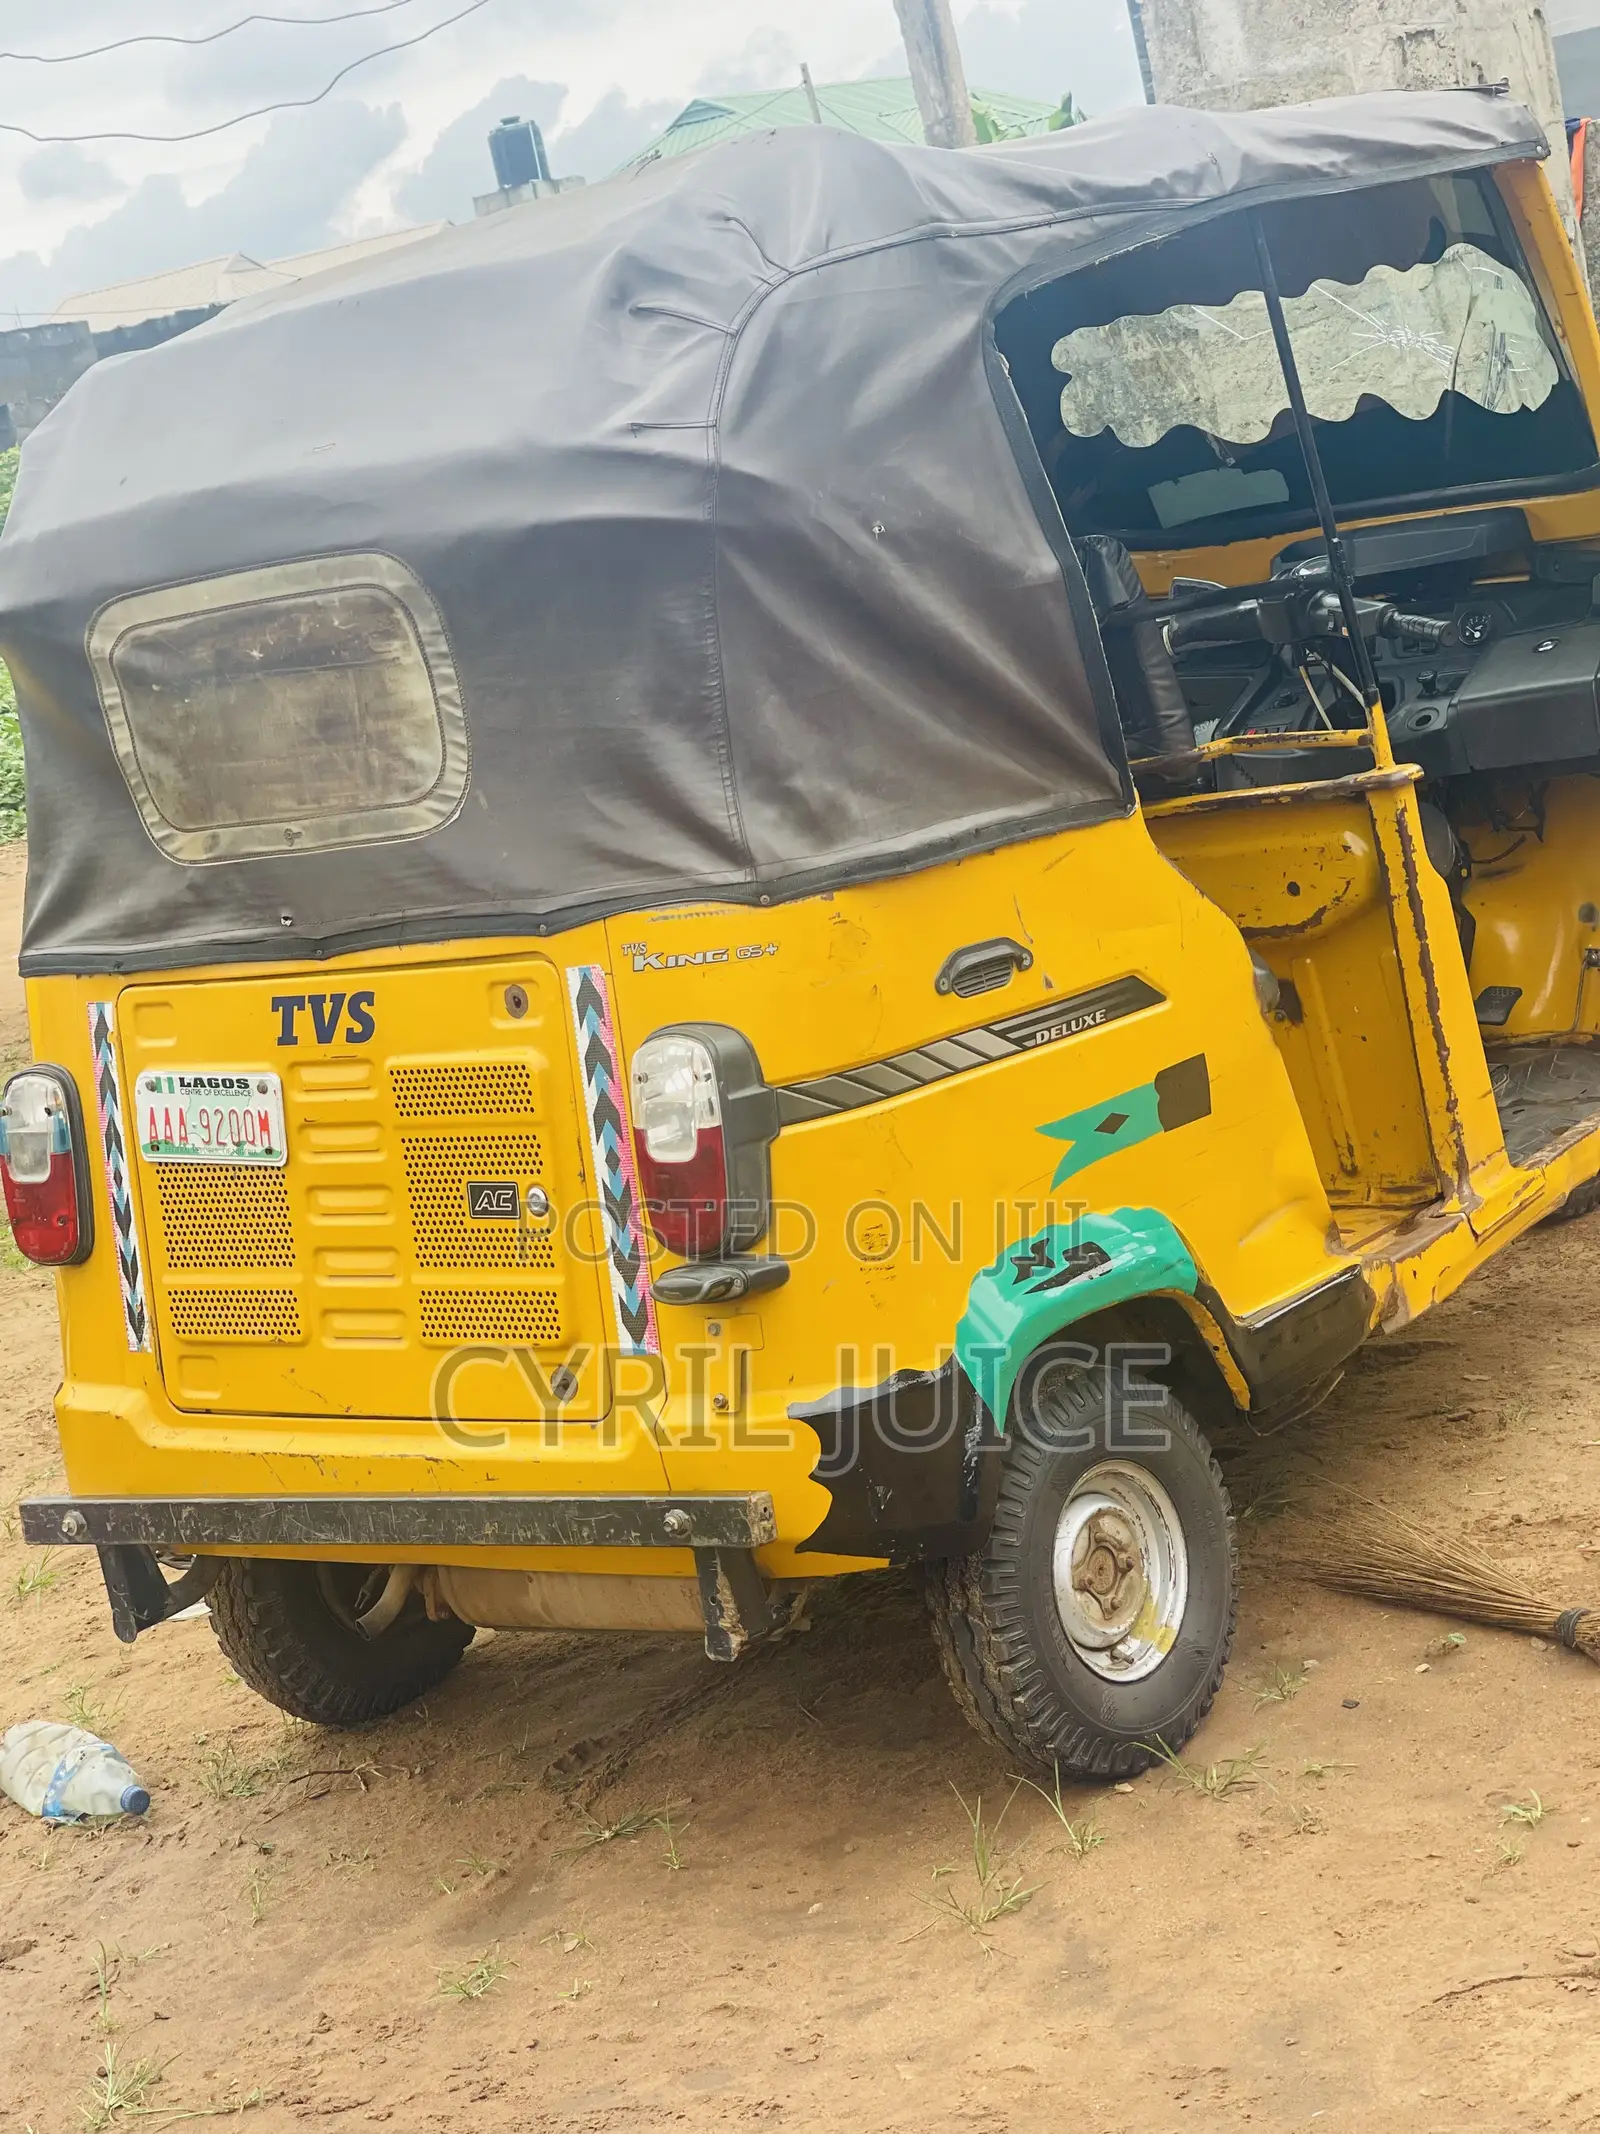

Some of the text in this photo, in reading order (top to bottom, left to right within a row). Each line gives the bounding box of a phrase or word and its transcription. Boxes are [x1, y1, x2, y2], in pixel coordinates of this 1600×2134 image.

[622, 943, 646, 956] TVS
[633, 949, 730, 972] KING
[272, 991, 375, 1046] TVS
[1036, 1009, 1106, 1044] DELUXE
[179, 1077, 250, 1089] LAGOS
[180, 1088, 202, 1096] CENTRE
[213, 1089, 252, 1097] EXCELLENCE
[475, 1190, 513, 1210] AC
